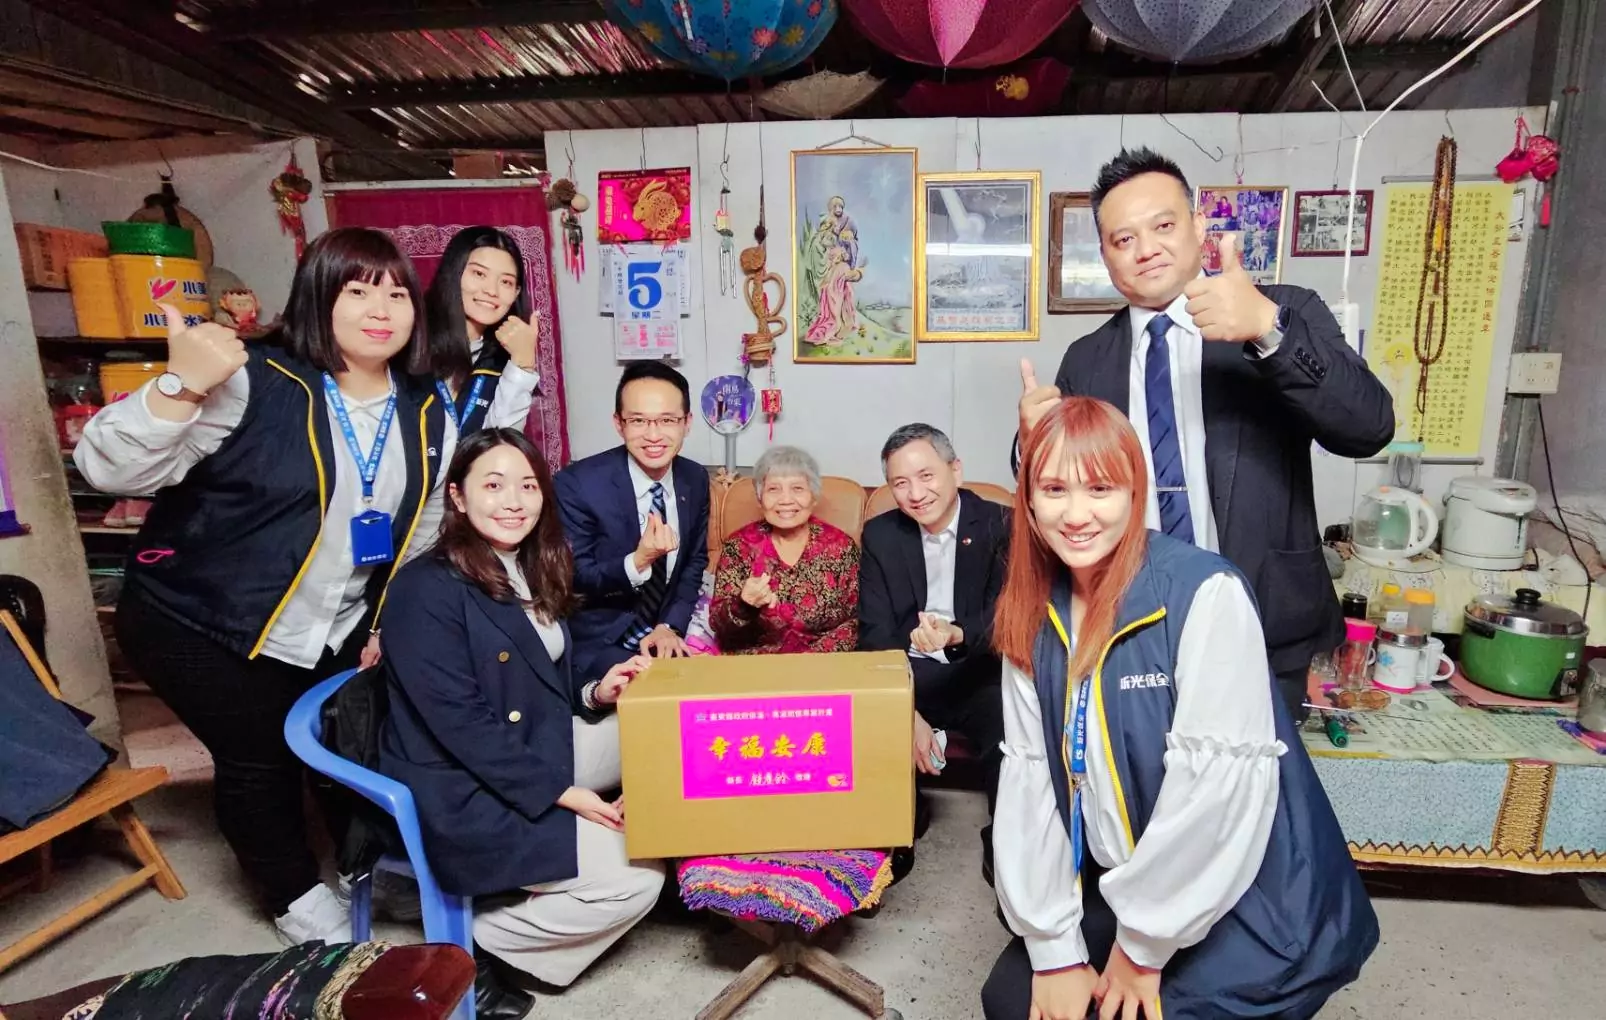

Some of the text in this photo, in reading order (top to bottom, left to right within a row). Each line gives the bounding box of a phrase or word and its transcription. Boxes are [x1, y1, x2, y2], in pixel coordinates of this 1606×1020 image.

[627, 261, 663, 310] 5
[708, 732, 828, 761] 幸福安康
